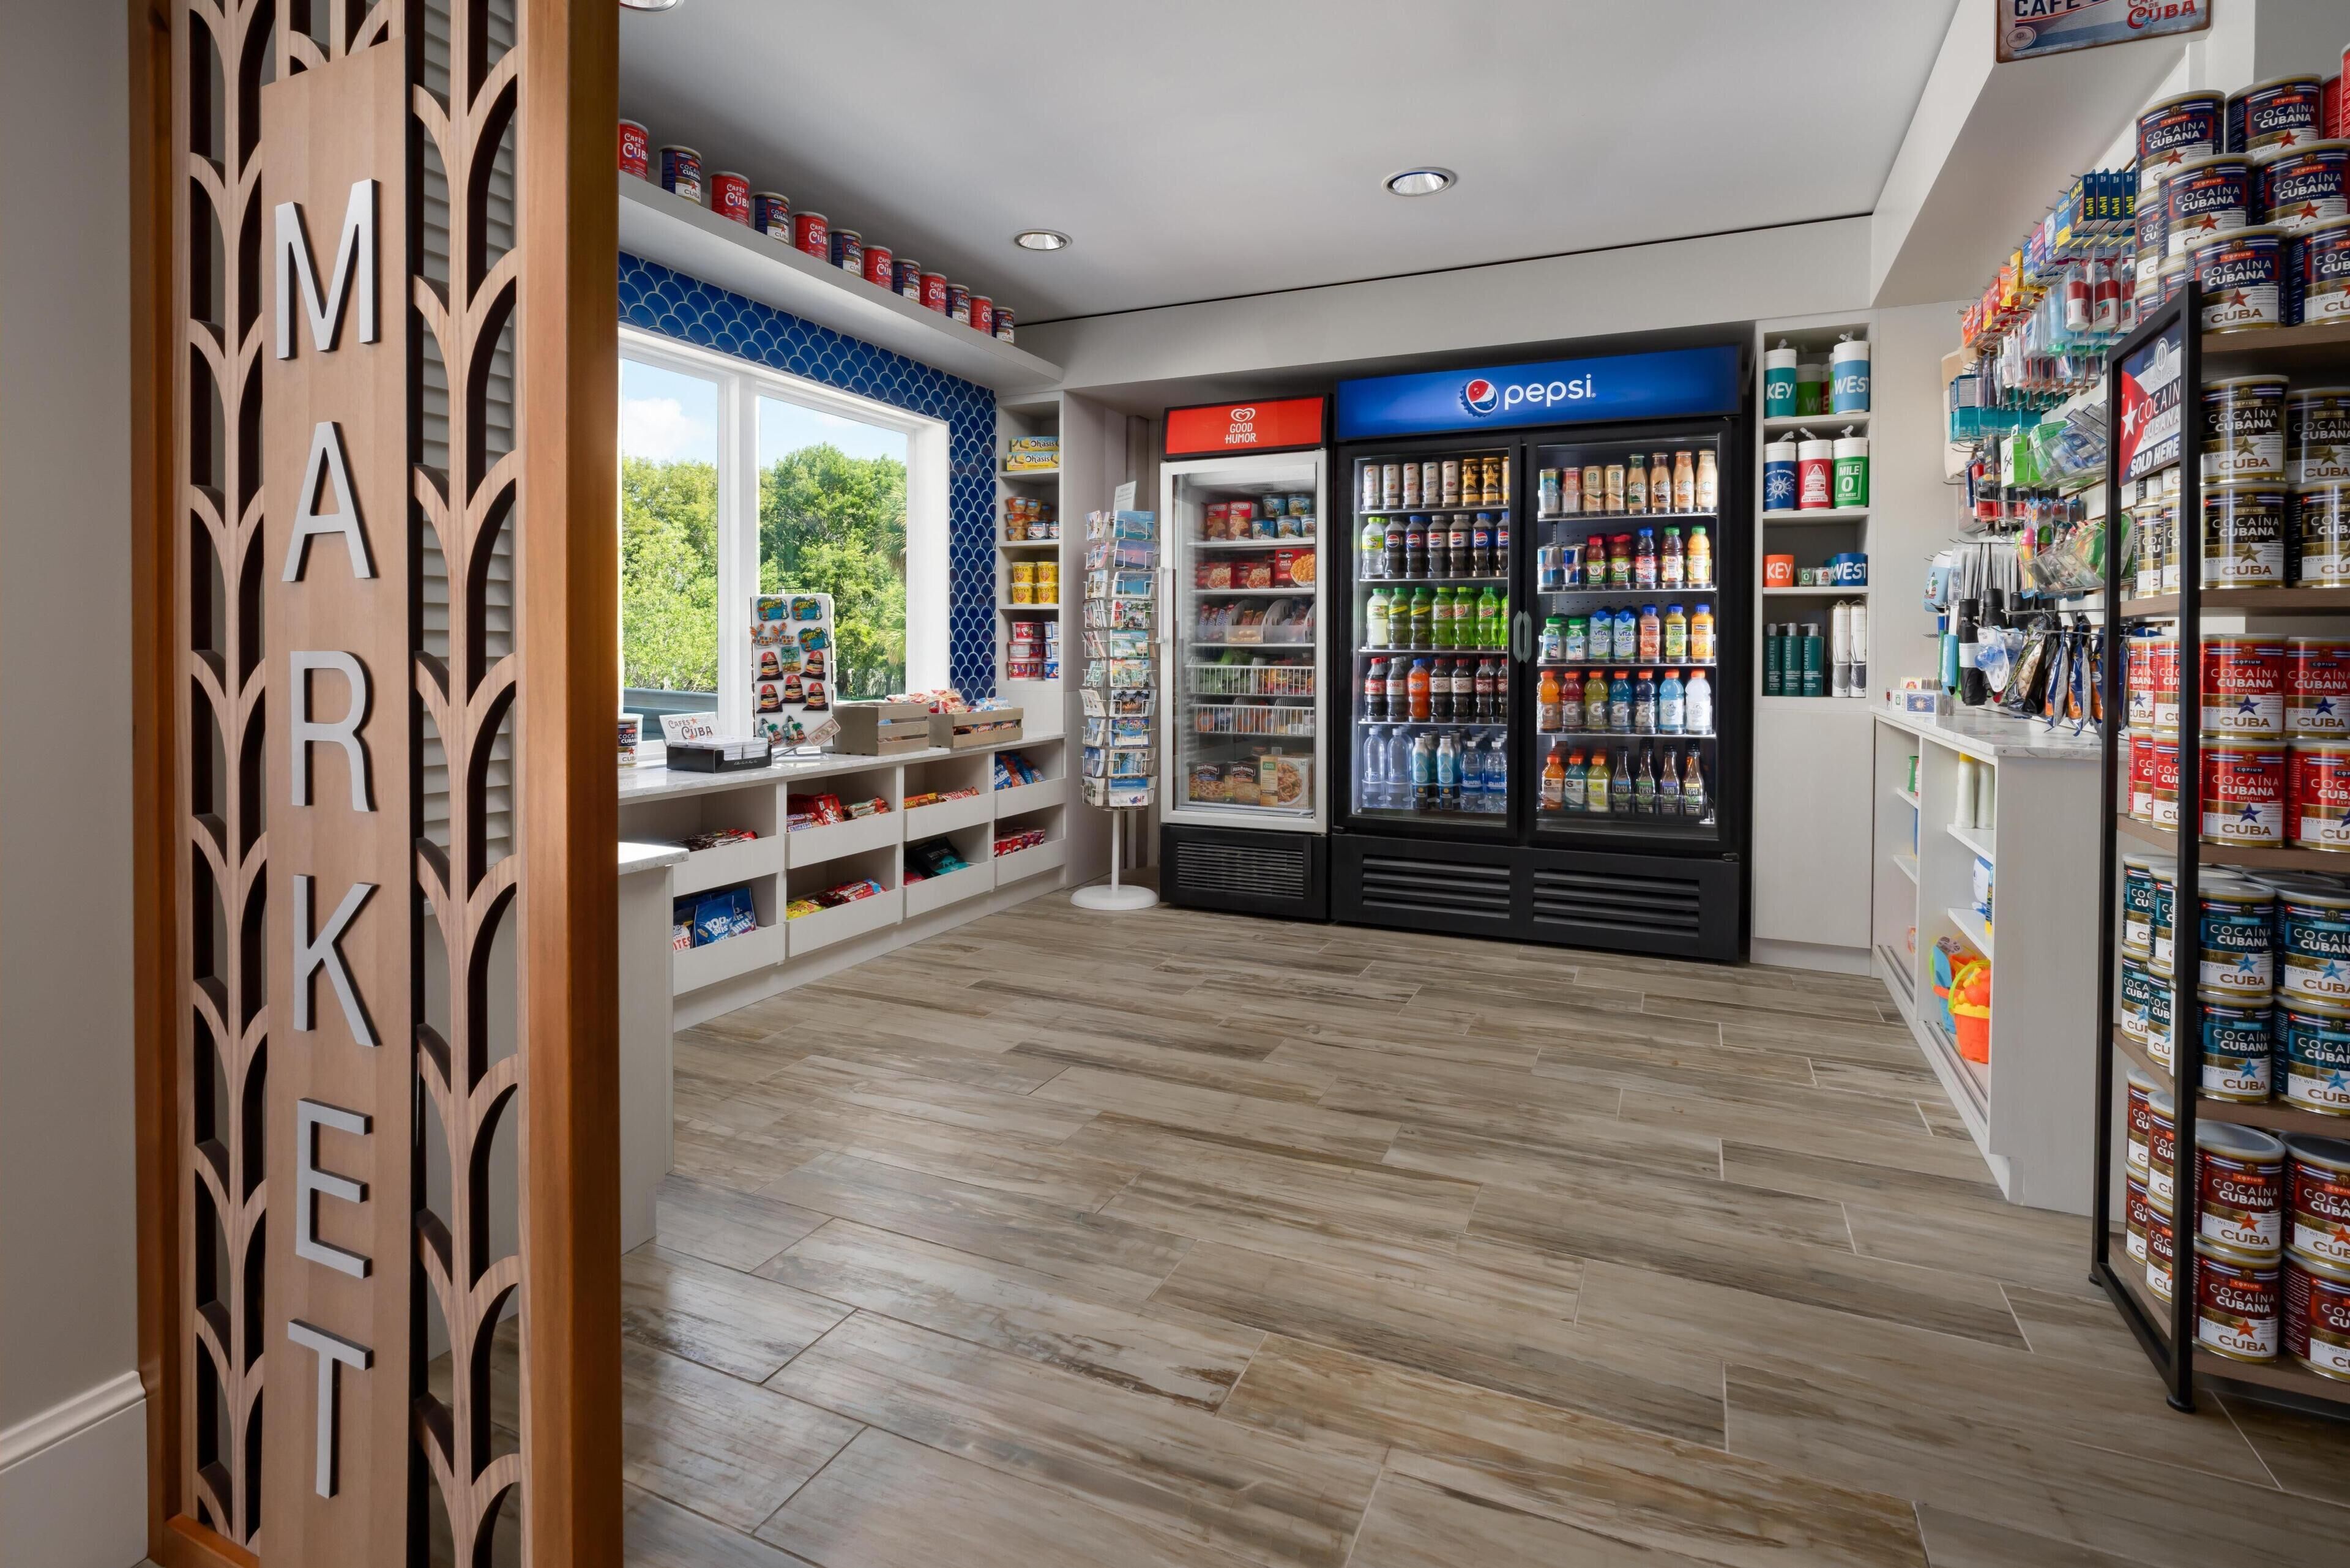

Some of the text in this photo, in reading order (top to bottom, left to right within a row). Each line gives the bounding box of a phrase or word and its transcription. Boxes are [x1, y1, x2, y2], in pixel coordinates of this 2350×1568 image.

[2127, 1, 2196, 29] CUBA
[2254, 103, 2315, 121] COCAÍNA
[2259, 114, 2311, 129] CUBANA
[624, 133, 644, 144] CAFÉS
[2146, 121, 2206, 143] COCAÍNA
[2150, 130, 2200, 149] CUBANA
[726, 184, 745, 193] CAFÉS
[2273, 173, 2341, 192] COCAÍNA
[684, 189, 700, 199] CUBA
[2176, 185, 2240, 204] COCAÍNA
[2279, 183, 2336, 200] CUBANA
[2181, 192, 2234, 212] CUBANA
[808, 231, 827, 245] CUB
[877, 264, 891, 276] CUB
[2203, 260, 2272, 278] COCAÍNA
[2208, 270, 2266, 286] CUBANA
[2210, 308, 2263, 323] CUBA
[1504, 373, 1591, 411] pepsi
[1767, 382, 1793, 400] KEY
[2137, 378, 2180, 424] COCAÍN
[2209, 408, 2277, 424] COCAÍNA
[1230, 423, 1253, 433] GOOD
[2143, 408, 2180, 441] CUBANA
[2215, 419, 2272, 432] CUBANA
[1225, 433, 1256, 444] HUMOR
[2130, 436, 2179, 477] SOLD HERE
[1839, 466, 1859, 476] MILE
[2218, 458, 2270, 470] CUBA
[2212, 515, 2279, 528] COCAÍNA
[2219, 528, 2275, 537] CUBANA
[1767, 562, 1792, 579] KEY
[2222, 566, 2273, 576] CUBA
[2210, 666, 2278, 678] COCAÍNA
[2217, 678, 2274, 688] CUBANA
[2294, 680, 2348, 689] CUBANA
[668, 719, 690, 729] CAFÉS
[2219, 717, 2271, 728] CUBA
[2297, 717, 2346, 728] CUBA
[681, 726, 714, 740] CUBA
[2212, 775, 2279, 786] COCAÍNA
[2218, 785, 2274, 796] CUBANA
[789, 823, 811, 832] SNICKERS
[2221, 823, 2272, 836] CUBA
[275, 178, 380, 1499] MARKET
[2210, 924, 2271, 936] COCAÍNA
[2217, 935, 2267, 947] CUBANA
[2301, 968, 2318, 977] WEST
[2220, 974, 2266, 986] CUBA
[2220, 1040, 2268, 1051] CUBANA
[2223, 1079, 2266, 1091] CUBA
[2306, 1078, 2322, 1087] WEST
[2212, 1178, 2278, 1197] COCAÍNA
[2219, 1190, 2274, 1207] CUBANA
[2203, 1214, 2236, 1228] KEY WEST
[2221, 1229, 2270, 1246] CUBA
[2296, 1223, 2328, 1239] KEY WEST
[2234, 1280, 2259, 1290] COPIUM
[2209, 1283, 2275, 1303] COCAÍNA
[2216, 1296, 2270, 1313] CUBANA
[2201, 1318, 2233, 1335] KEY WEST
[2218, 1334, 2268, 1353] CUBA
[2311, 1340, 2349, 1356] KEY WEST
